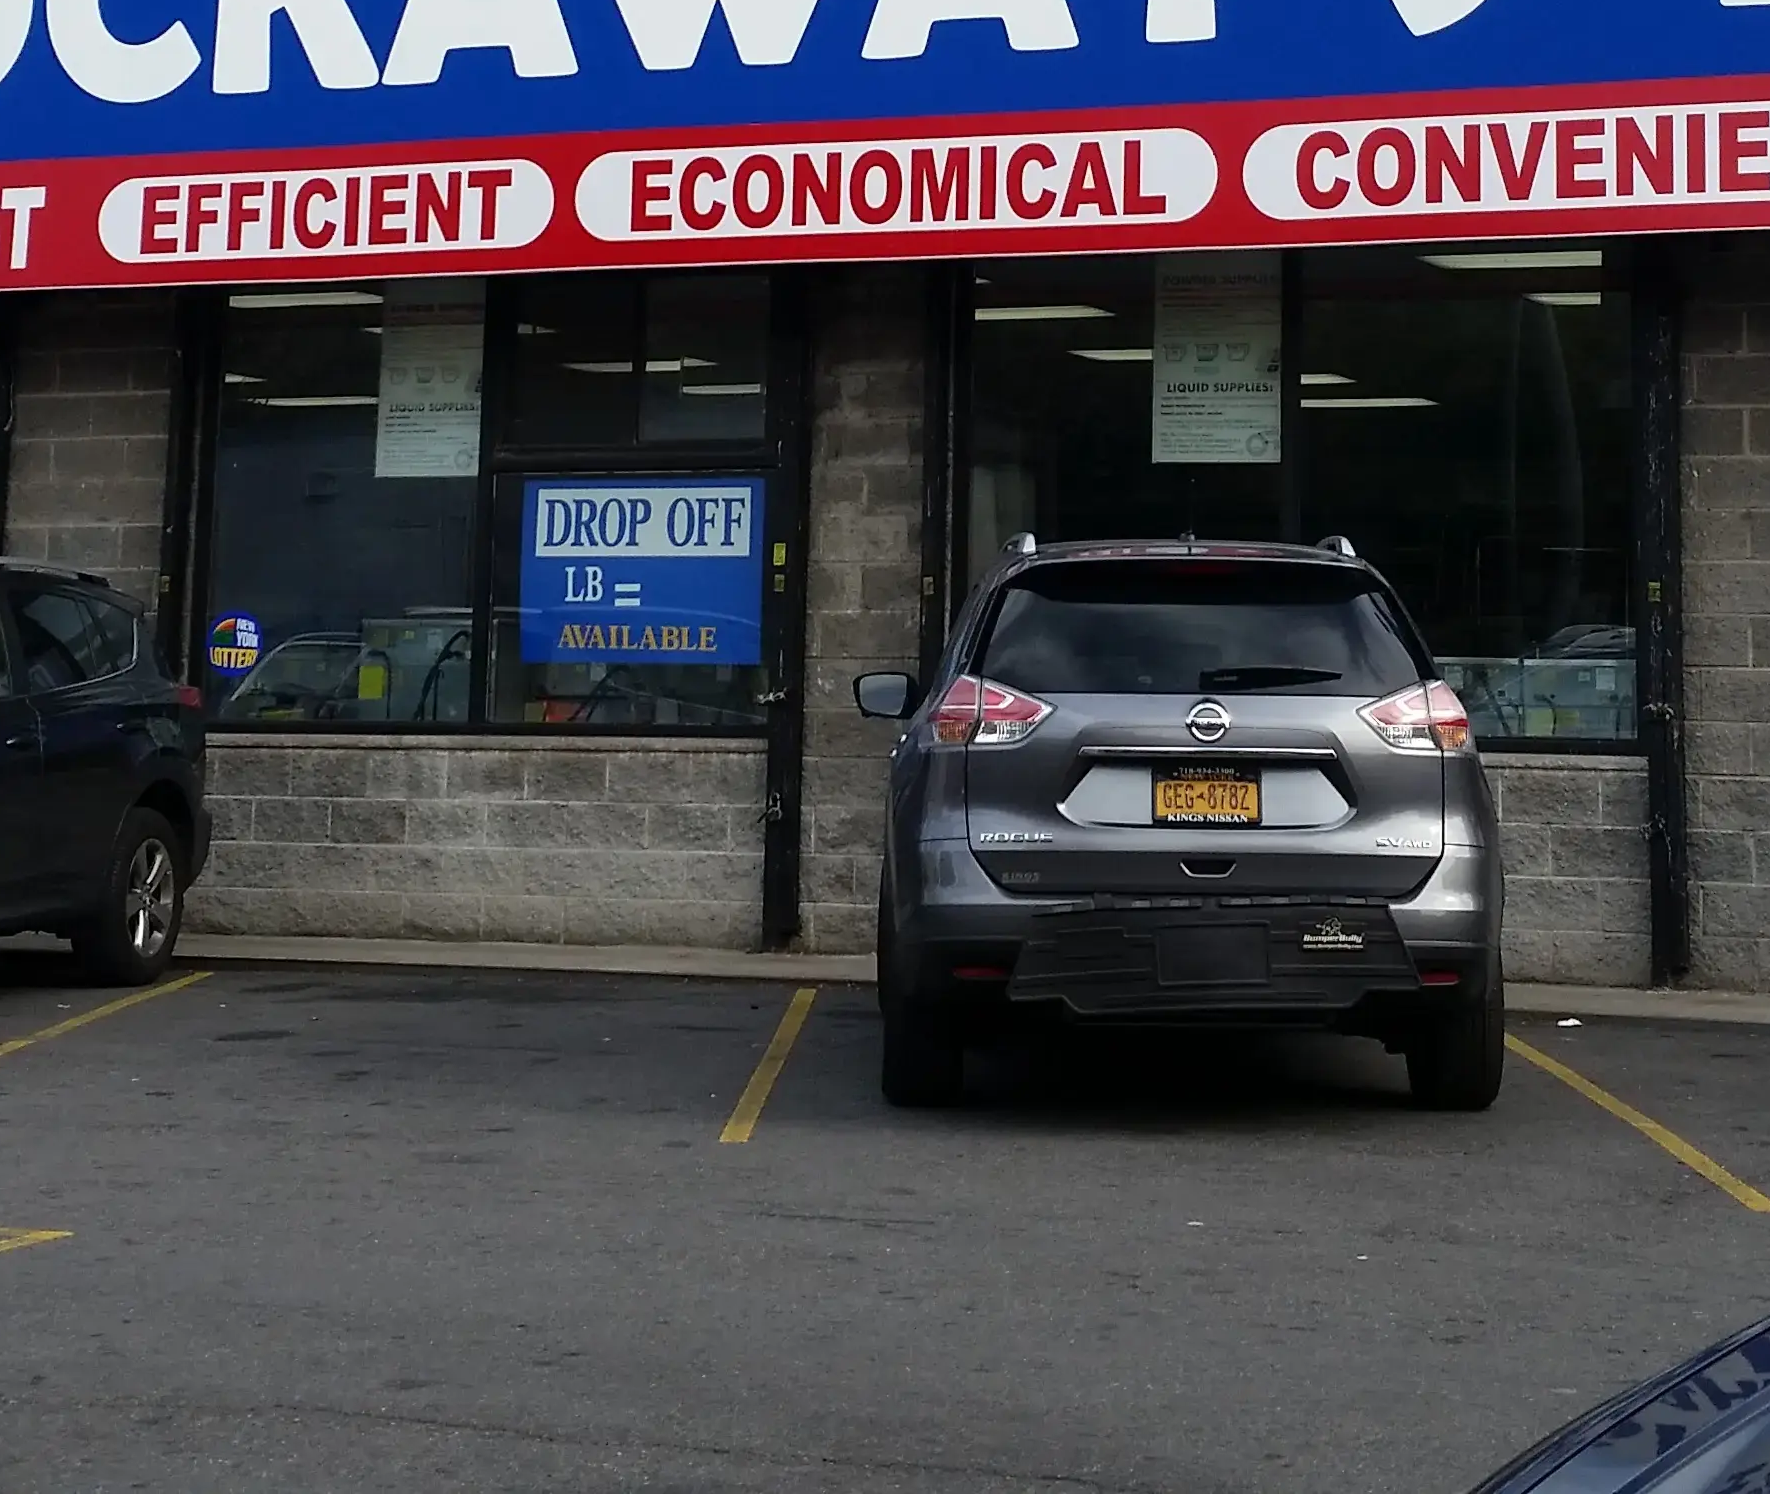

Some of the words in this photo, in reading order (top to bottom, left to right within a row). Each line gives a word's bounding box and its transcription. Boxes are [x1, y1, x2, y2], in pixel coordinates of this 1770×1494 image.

[139, 168, 513, 255] EFFICIENT
[629, 139, 1167, 233] ECONOMICAL
[1167, 383, 1209, 393] LIQUID
[389, 403, 425, 413] LIQUID
[543, 497, 653, 547] DROP
[666, 496, 746, 547] OFF
[564, 566, 604, 602] LB
[557, 624, 718, 652] AVAILABLE
[1167, 813, 1204, 822] KINGS
[1206, 813, 1248, 823] NISSAN
[980, 832, 1054, 843] ROGUE
[1375, 837, 1404, 847] SV
[1403, 839, 1433, 848] AWD
